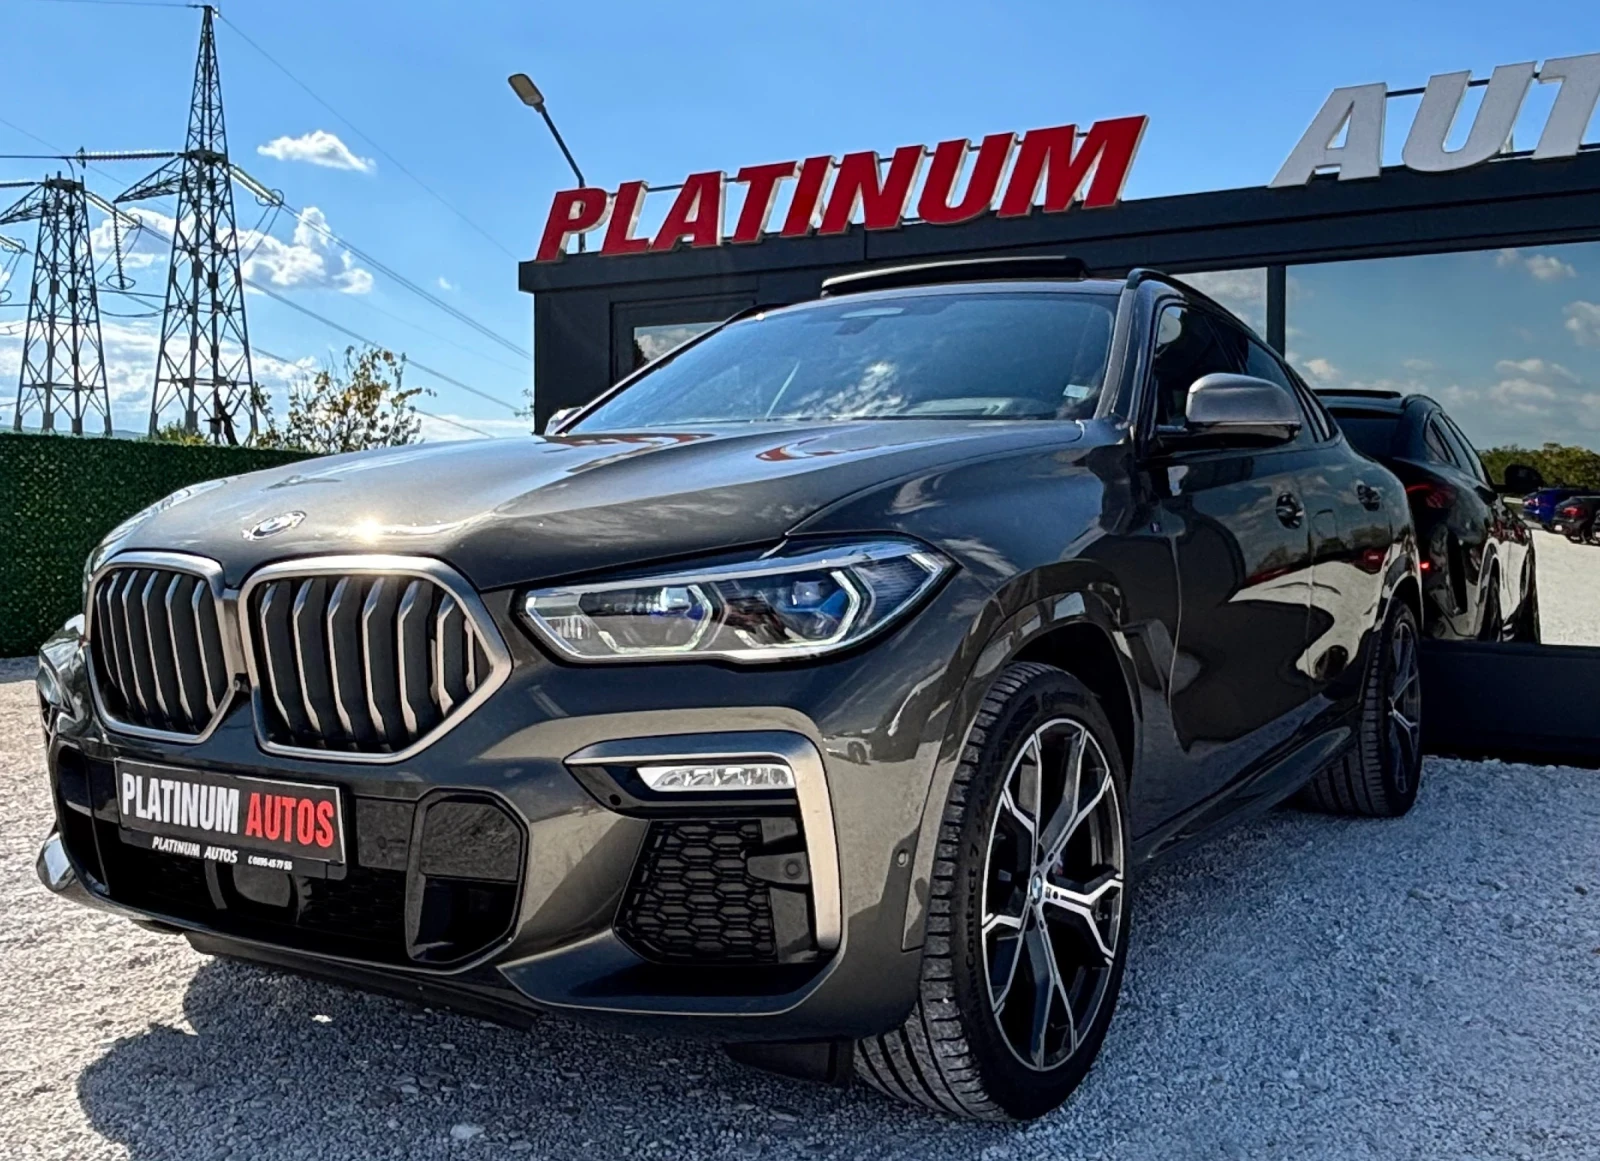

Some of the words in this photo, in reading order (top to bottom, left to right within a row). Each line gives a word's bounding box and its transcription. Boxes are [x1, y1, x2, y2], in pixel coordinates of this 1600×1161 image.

[534, 114, 1150, 264] PLATINUM
[121, 773, 240, 835] PLATINUM
[245, 792, 335, 848] AUTOS
[151, 836, 201, 857] PLATINUM
[204, 846, 239, 864] AUTOS
